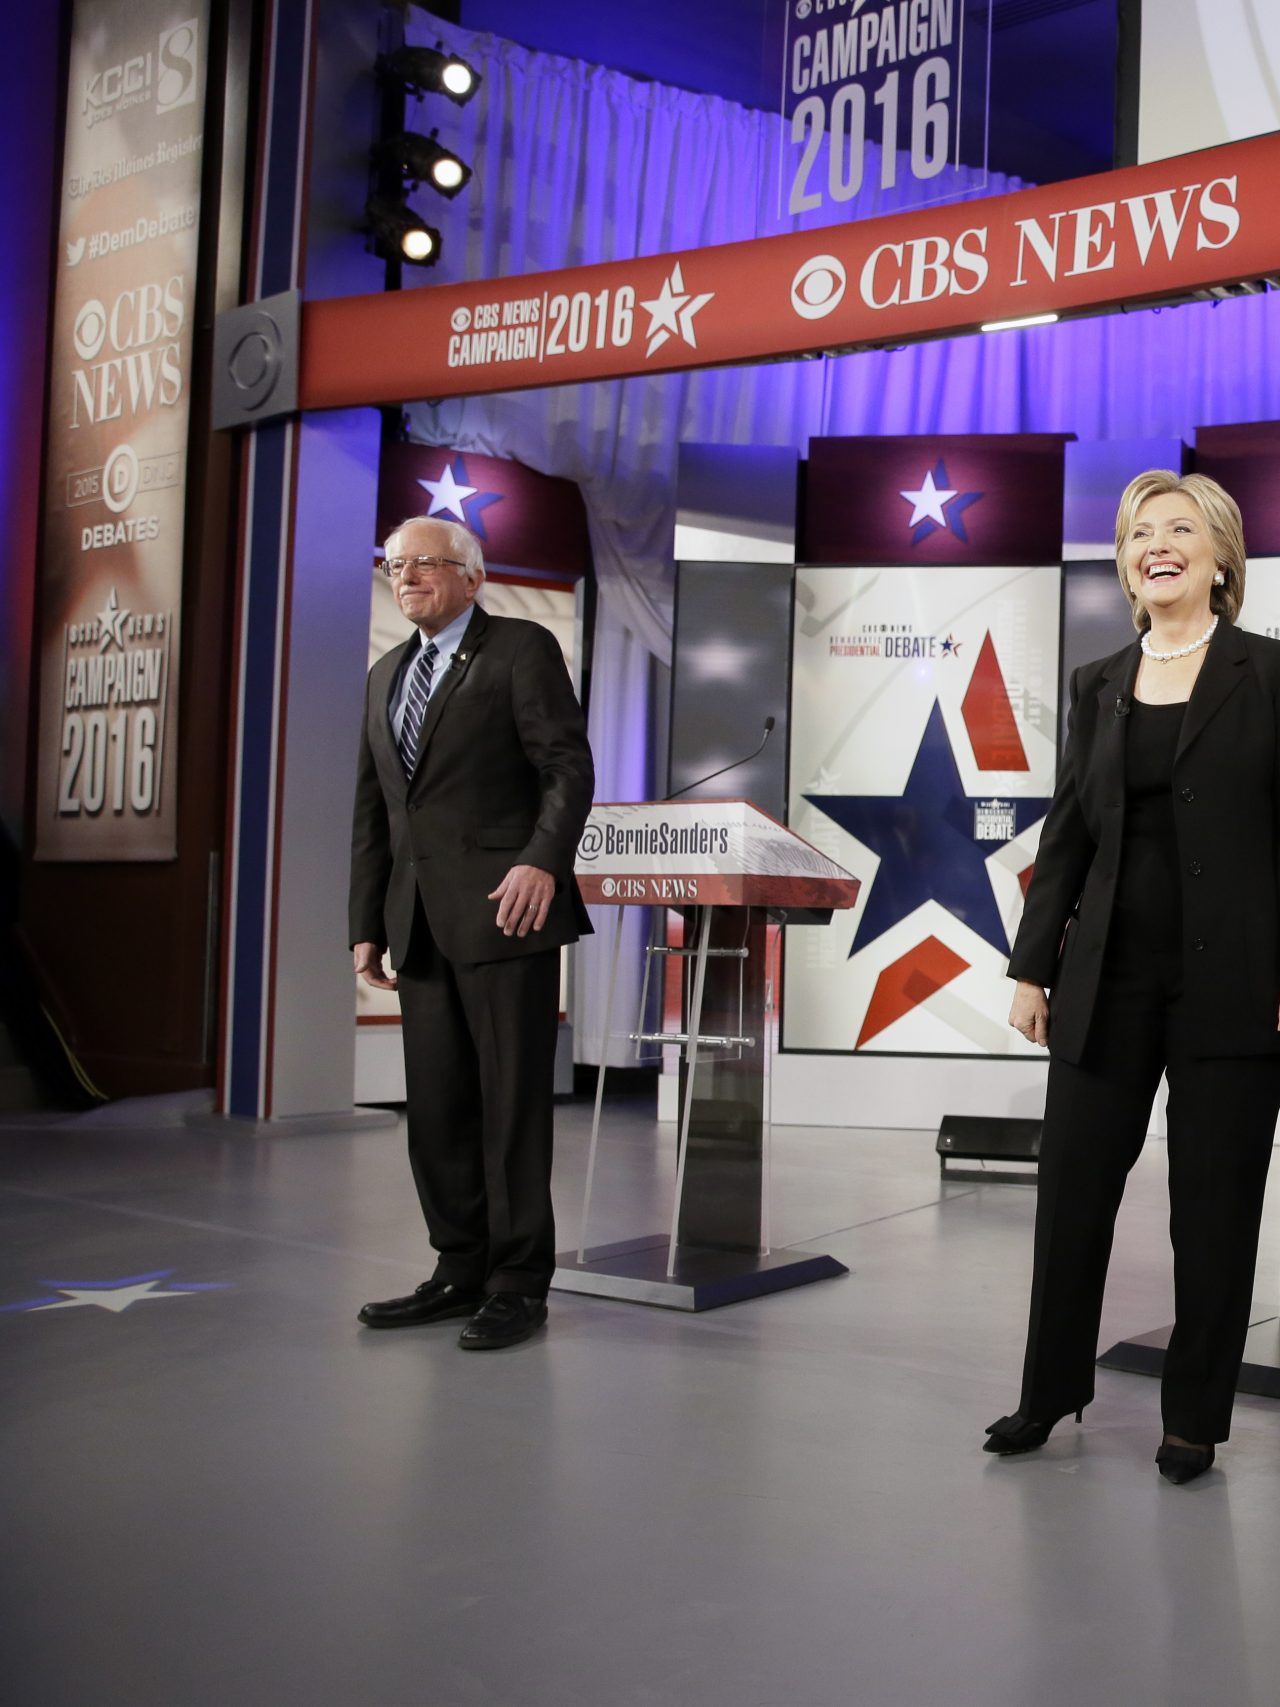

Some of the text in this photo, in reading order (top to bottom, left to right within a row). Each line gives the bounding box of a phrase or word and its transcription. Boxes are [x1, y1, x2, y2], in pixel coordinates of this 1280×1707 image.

[792, 0, 953, 94] CAMPAIGN
[83, 52, 152, 116] KCCI
[788, 56, 950, 215] 2016
[88, 207, 195, 260] #DemDebate
[859, 175, 1241, 310] CBS NEWS
[110, 276, 185, 353] CBS
[473, 297, 541, 330] CBS NEWS
[546, 285, 635, 356] 2016
[448, 325, 538, 368] CAMPAIGN
[69, 343, 183, 429] NEWS
[81, 516, 161, 551] DEBATES
[885, 636, 937, 658] DEBATE
[65, 648, 161, 708] CAMPAIGN
[58, 706, 156, 815] 2016
[576, 822, 728, 861] @BernieSanders
[976, 822, 1014, 840] DEBATE
[616, 879, 698, 898] CBS NEWS
